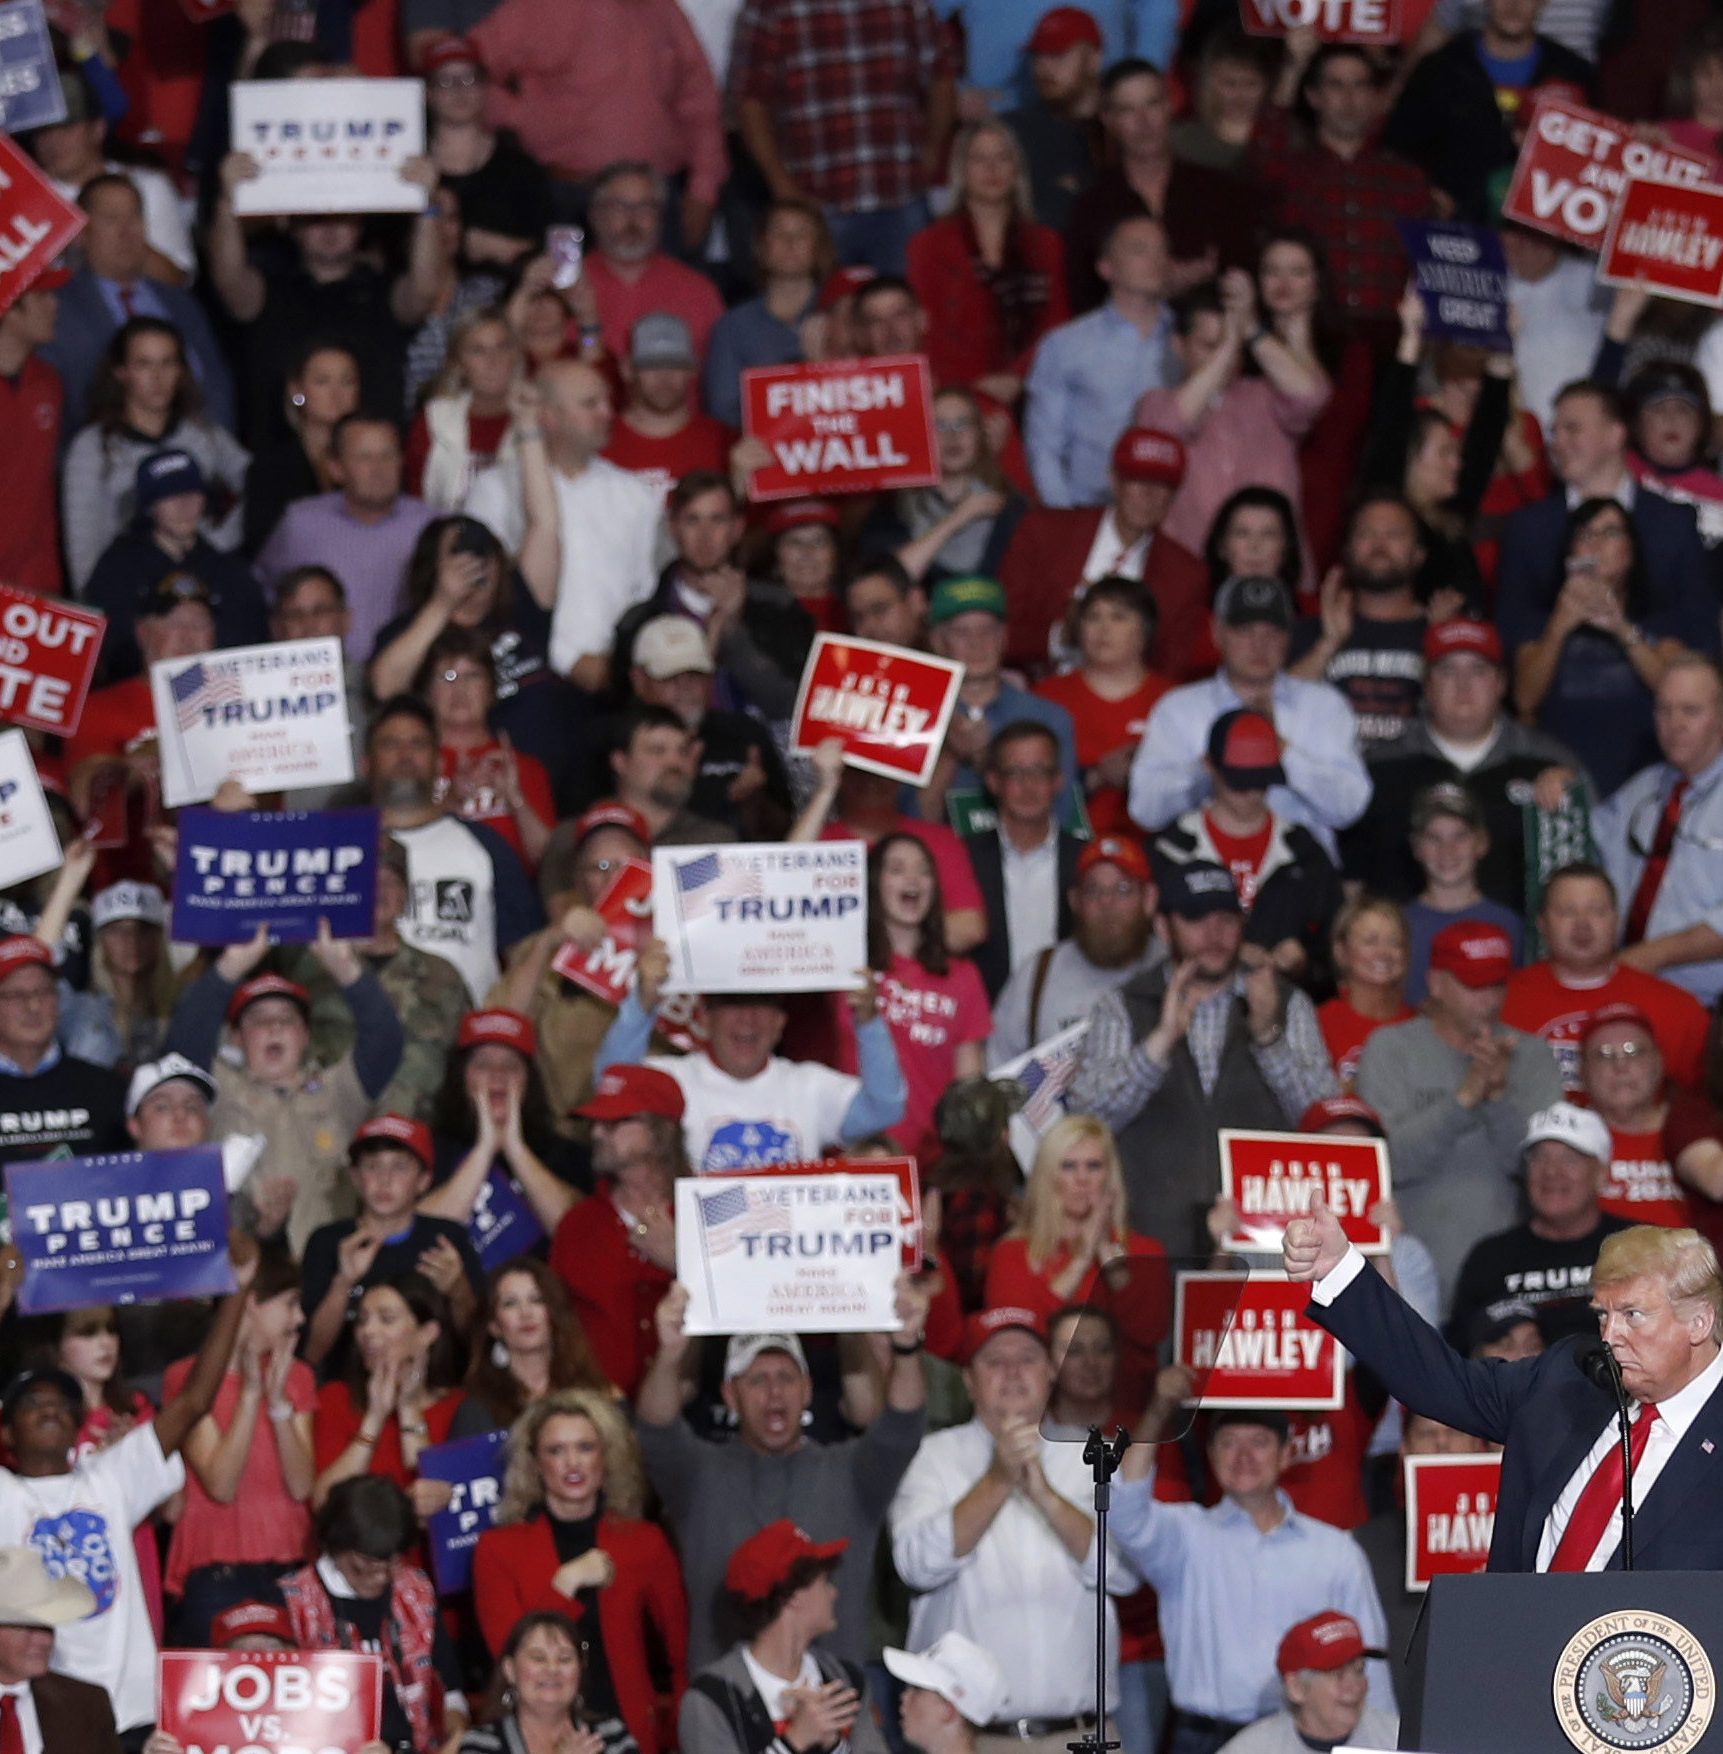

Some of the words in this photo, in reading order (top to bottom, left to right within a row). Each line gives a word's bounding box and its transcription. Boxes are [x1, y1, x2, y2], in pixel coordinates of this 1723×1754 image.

[248, 120, 406, 143] TRUMP
[1536, 113, 1613, 155] GET
[767, 375, 904, 415] FINISH
[777, 434, 908, 473] WALL
[7, 603, 97, 657] OUT
[203, 691, 337, 729] TRUMP
[190, 845, 365, 878] TRUMP
[715, 896, 860, 923] TRUMP
[26, 1189, 211, 1235] TRUMP
[759, 1184, 894, 1204] VETERANS
[47, 1220, 197, 1255] PENCE
[741, 1232, 893, 1257] TRUMP
[1504, 1266, 1592, 1292] TRUM
[1193, 1329, 1321, 1369] HAWLEY
[1633, 1618, 1648, 1628] OF
[1651, 1621, 1672, 1637] THE
[1559, 1617, 1629, 1688] PRESIDENT
[1676, 1634, 1709, 1699] UNITED
[190, 1665, 352, 1713] JOBS
[1561, 1694, 1572, 1717] THE
